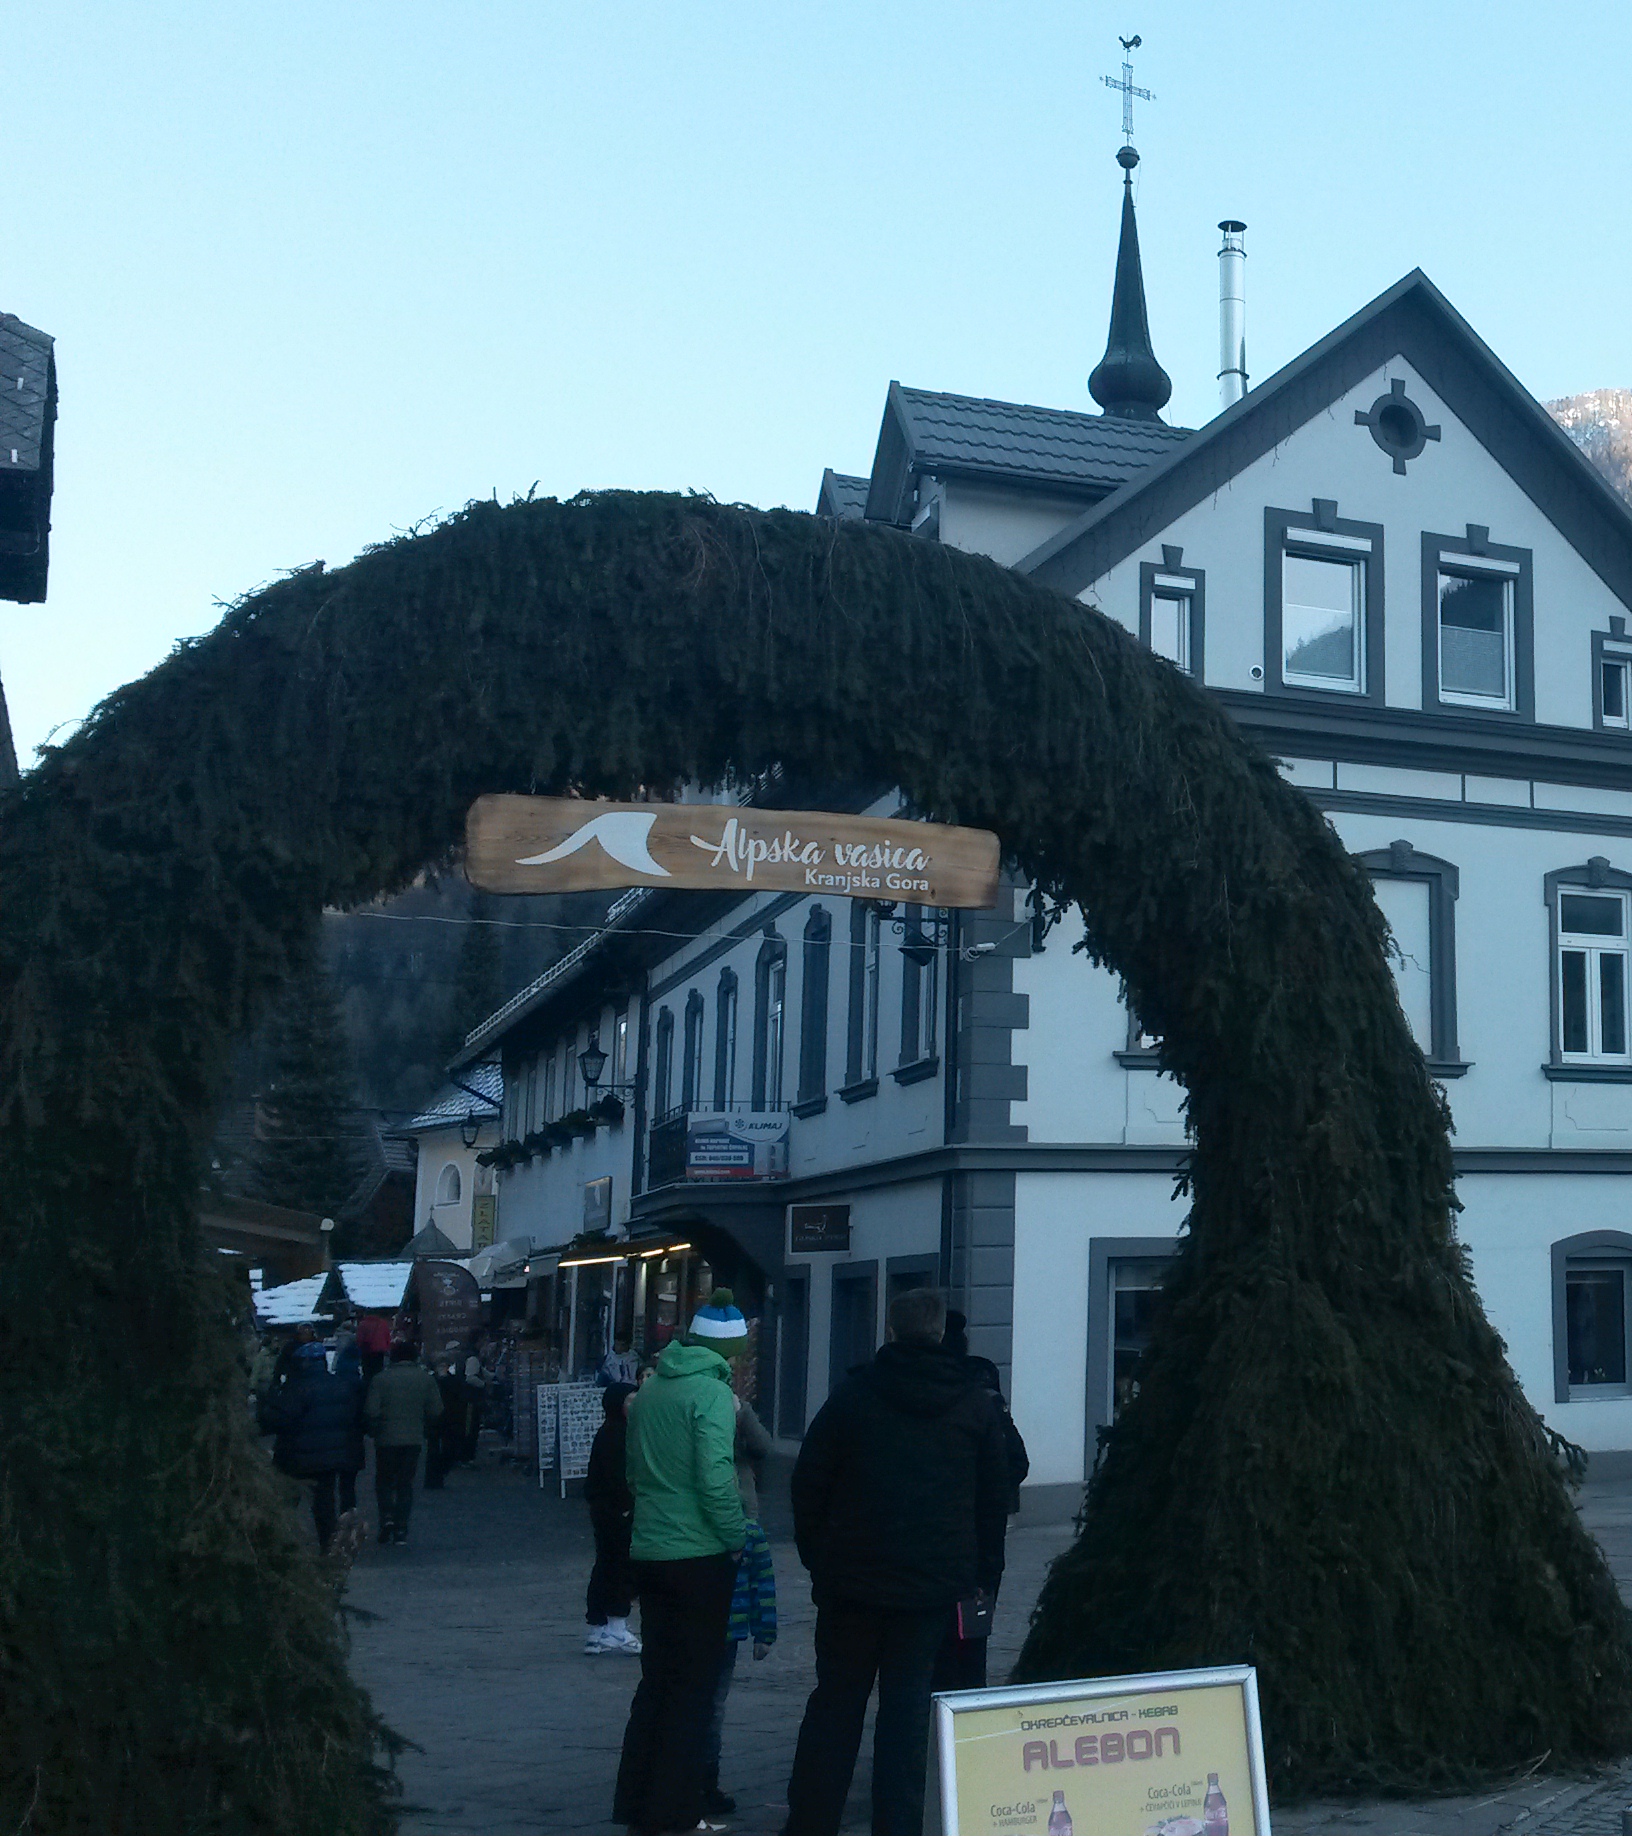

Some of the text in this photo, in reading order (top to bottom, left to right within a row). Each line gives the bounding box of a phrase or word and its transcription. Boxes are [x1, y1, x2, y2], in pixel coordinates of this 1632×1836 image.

[690, 817, 930, 881] Alpska vasica
[804, 867, 930, 893] Kranjska Gora
[1020, 1709, 1129, 1732] OKREPČEVALNICA
[1138, 1705, 1179, 1720] KEBAB
[1022, 1726, 1182, 1773] ALEBON
[1147, 1783, 1192, 1799] Coca-Cola
[990, 1801, 1036, 1818] Coca-Cola
